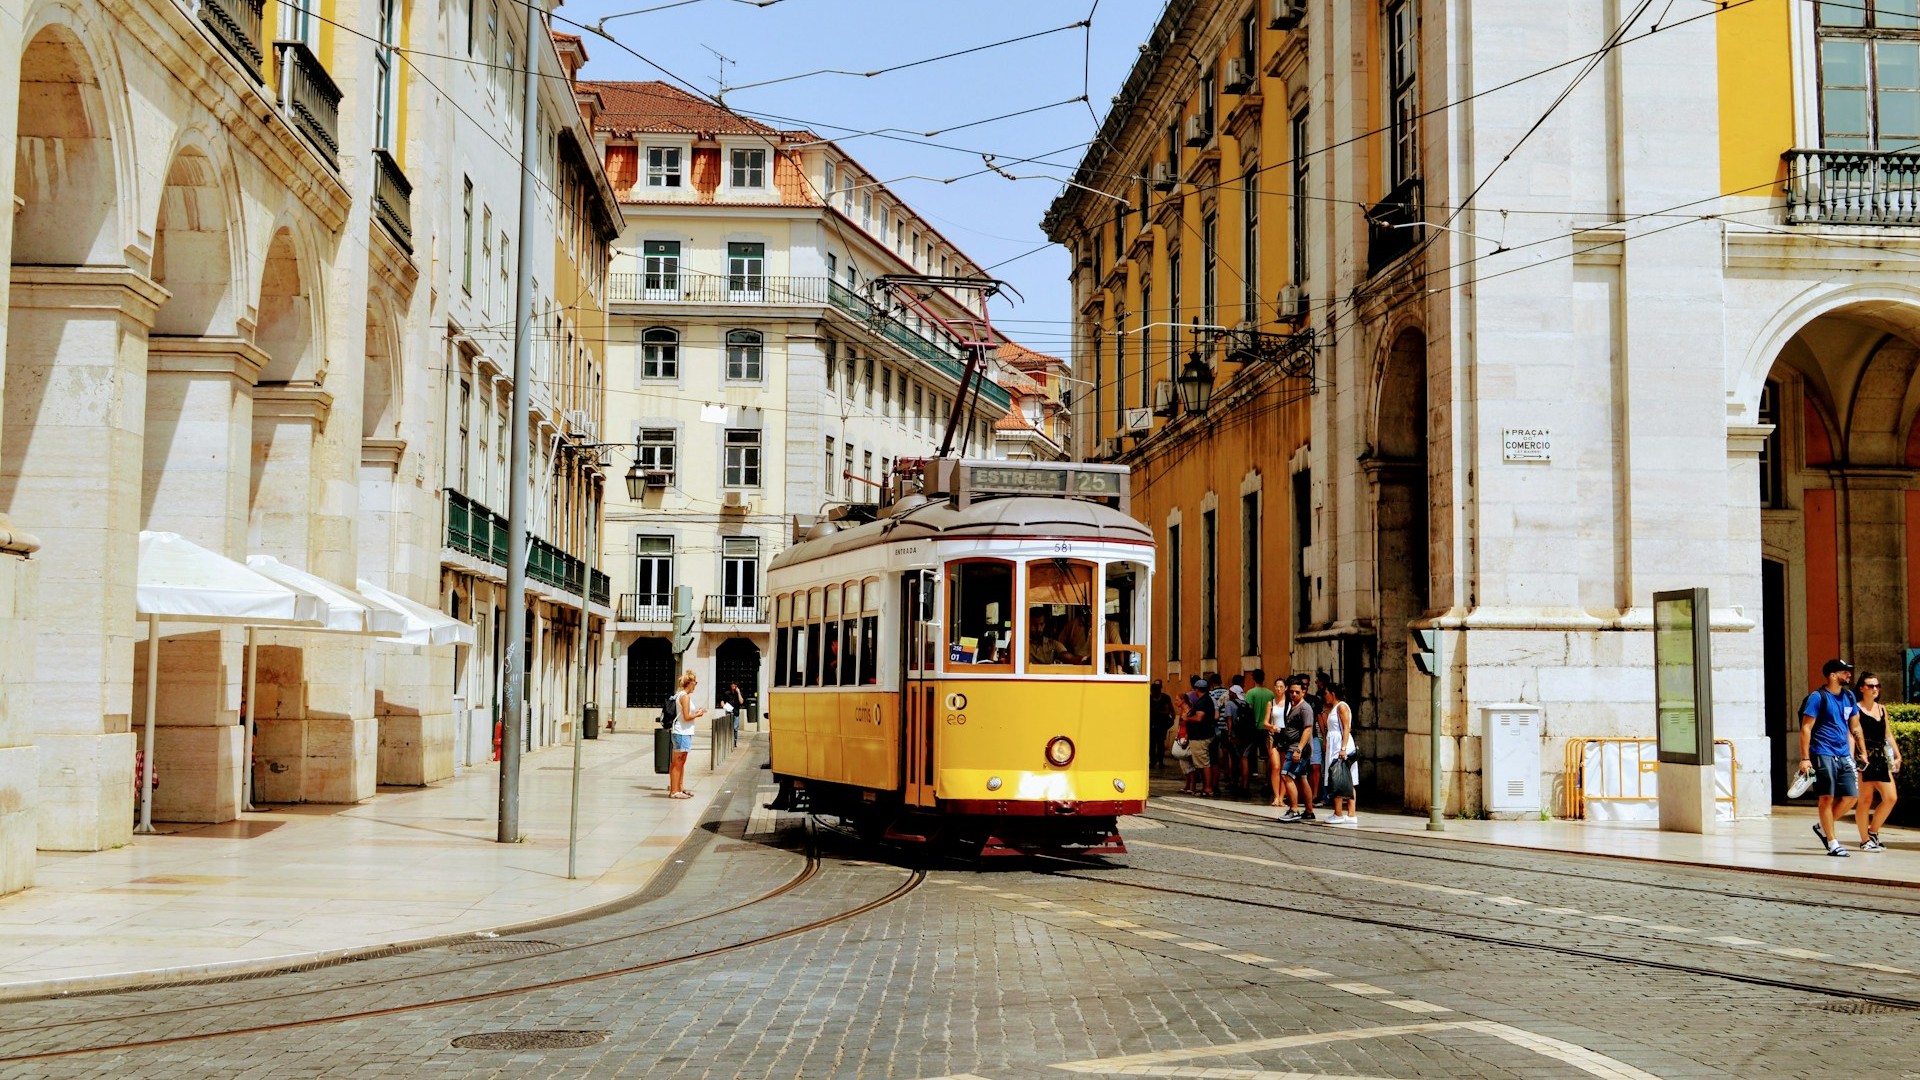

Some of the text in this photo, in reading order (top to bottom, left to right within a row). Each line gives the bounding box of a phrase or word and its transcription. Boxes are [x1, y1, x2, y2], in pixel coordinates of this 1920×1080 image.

[1511, 429, 1544, 437] PRAÇA
[1505, 441, 1551, 450] COMERCIO
[976, 469, 1057, 484] ESTRELA
[1078, 472, 1106, 491] 25
[895, 547, 917, 556] ENTRADA
[1054, 543, 1072, 553] 581
[951, 653, 960, 661] 01
